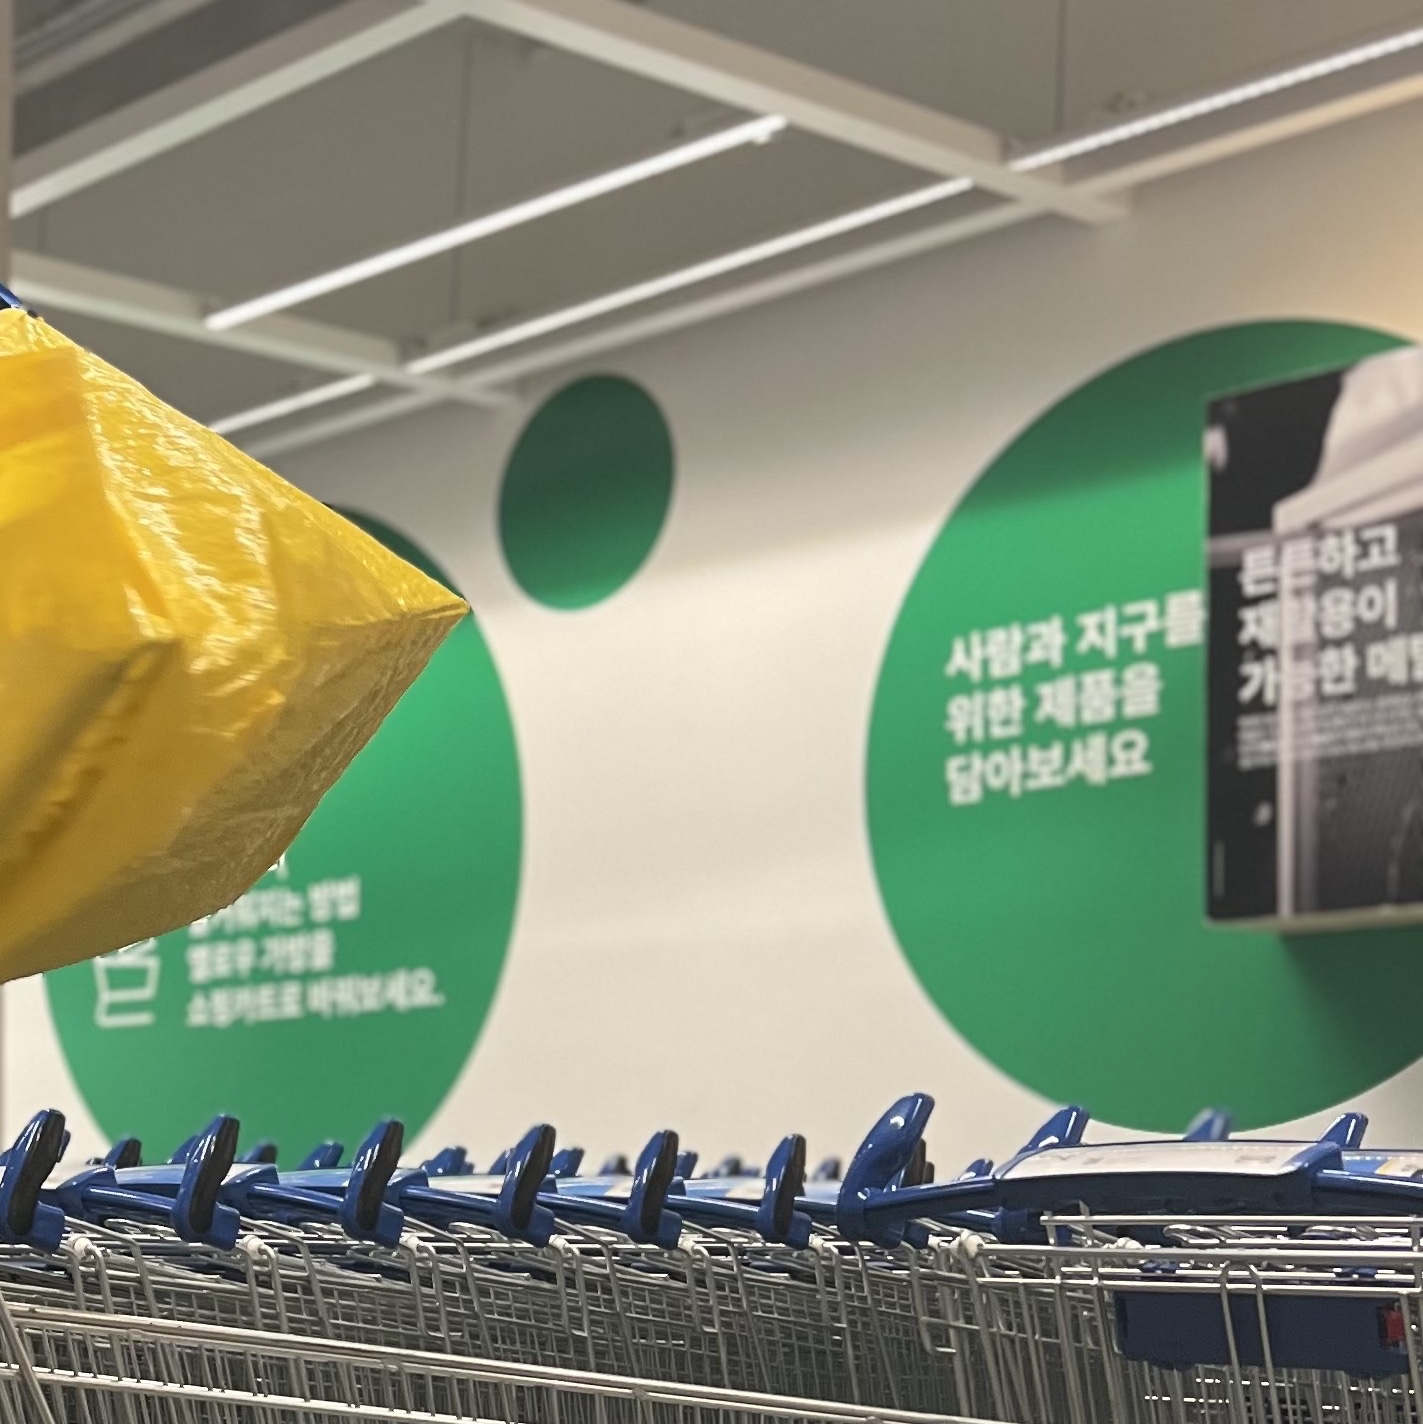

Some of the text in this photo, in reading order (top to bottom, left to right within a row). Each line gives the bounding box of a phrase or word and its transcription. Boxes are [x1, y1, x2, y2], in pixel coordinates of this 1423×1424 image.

[1237, 524, 1401, 597] 튼튼하고
[945, 589, 1207, 683] 사람과 지구를
[945, 661, 1162, 745] 위한 제품을
[945, 728, 1152, 805] 담아보세요
[307, 873, 361, 923] 방법
